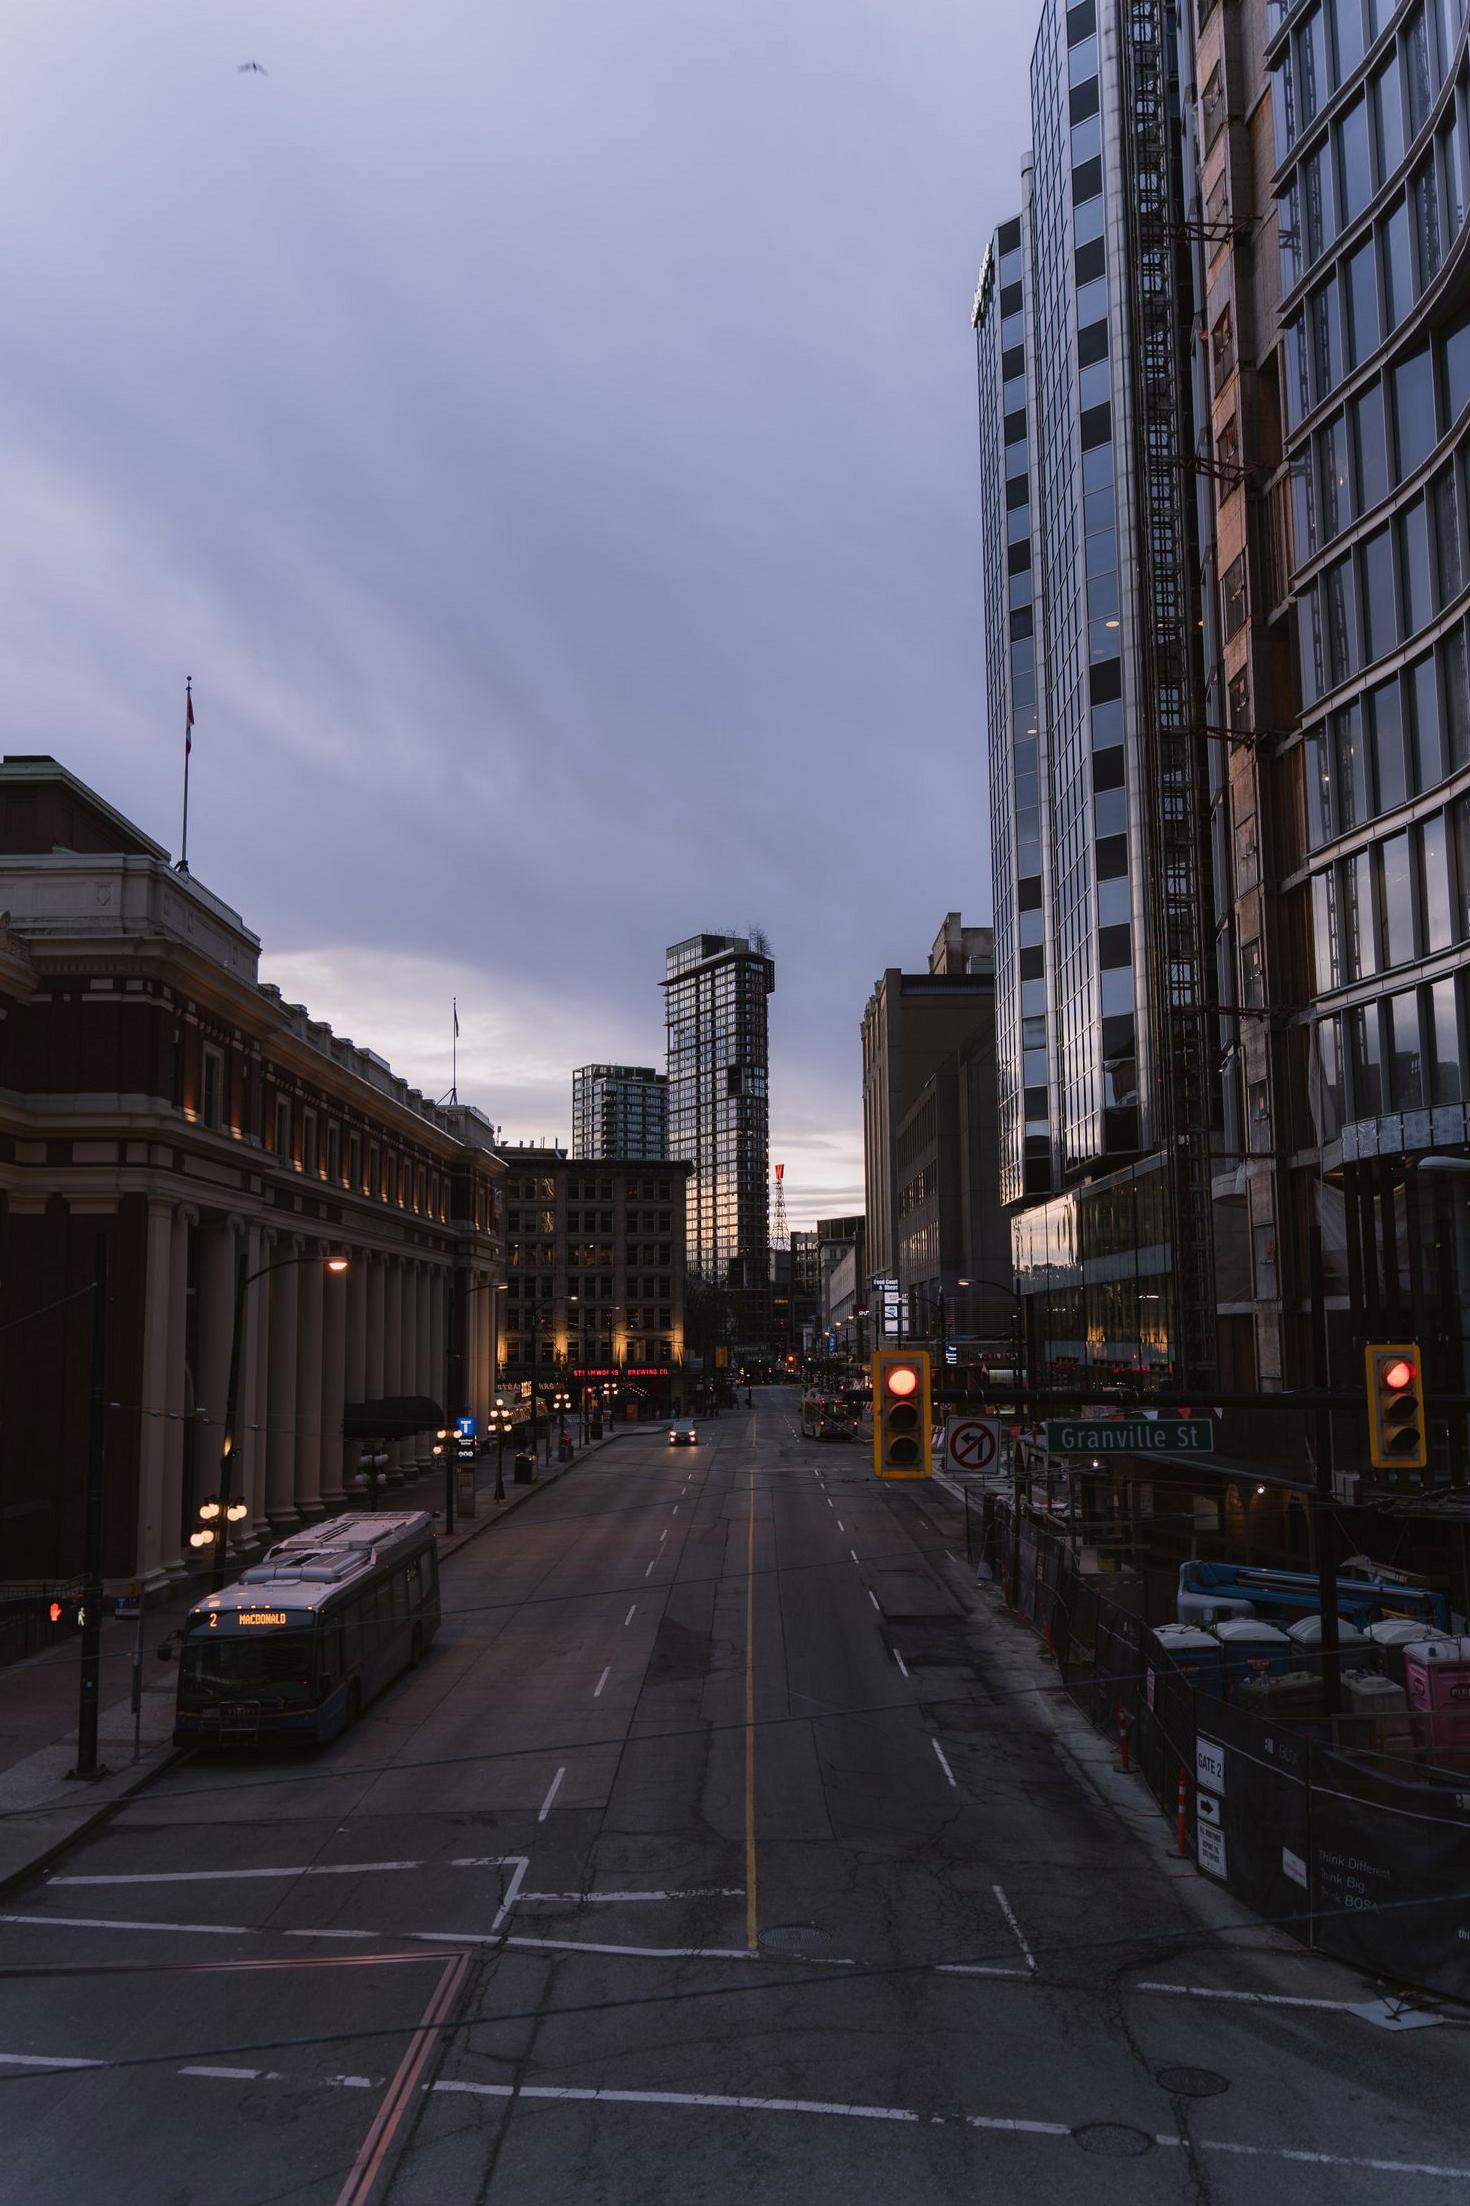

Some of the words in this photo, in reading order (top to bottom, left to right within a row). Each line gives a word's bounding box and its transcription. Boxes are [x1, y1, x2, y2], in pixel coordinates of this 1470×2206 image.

[627, 1368, 657, 1376] BREWING
[1061, 1425, 1166, 1449] Granville
[1177, 1426, 1198, 1447] St
[210, 1613, 218, 1627] 2
[239, 1613, 286, 1625] MACDONALD
[1198, 1752, 1215, 1775] GATE
[1216, 1763, 1222, 1778] 2
[1319, 1850, 1345, 1867] Think
